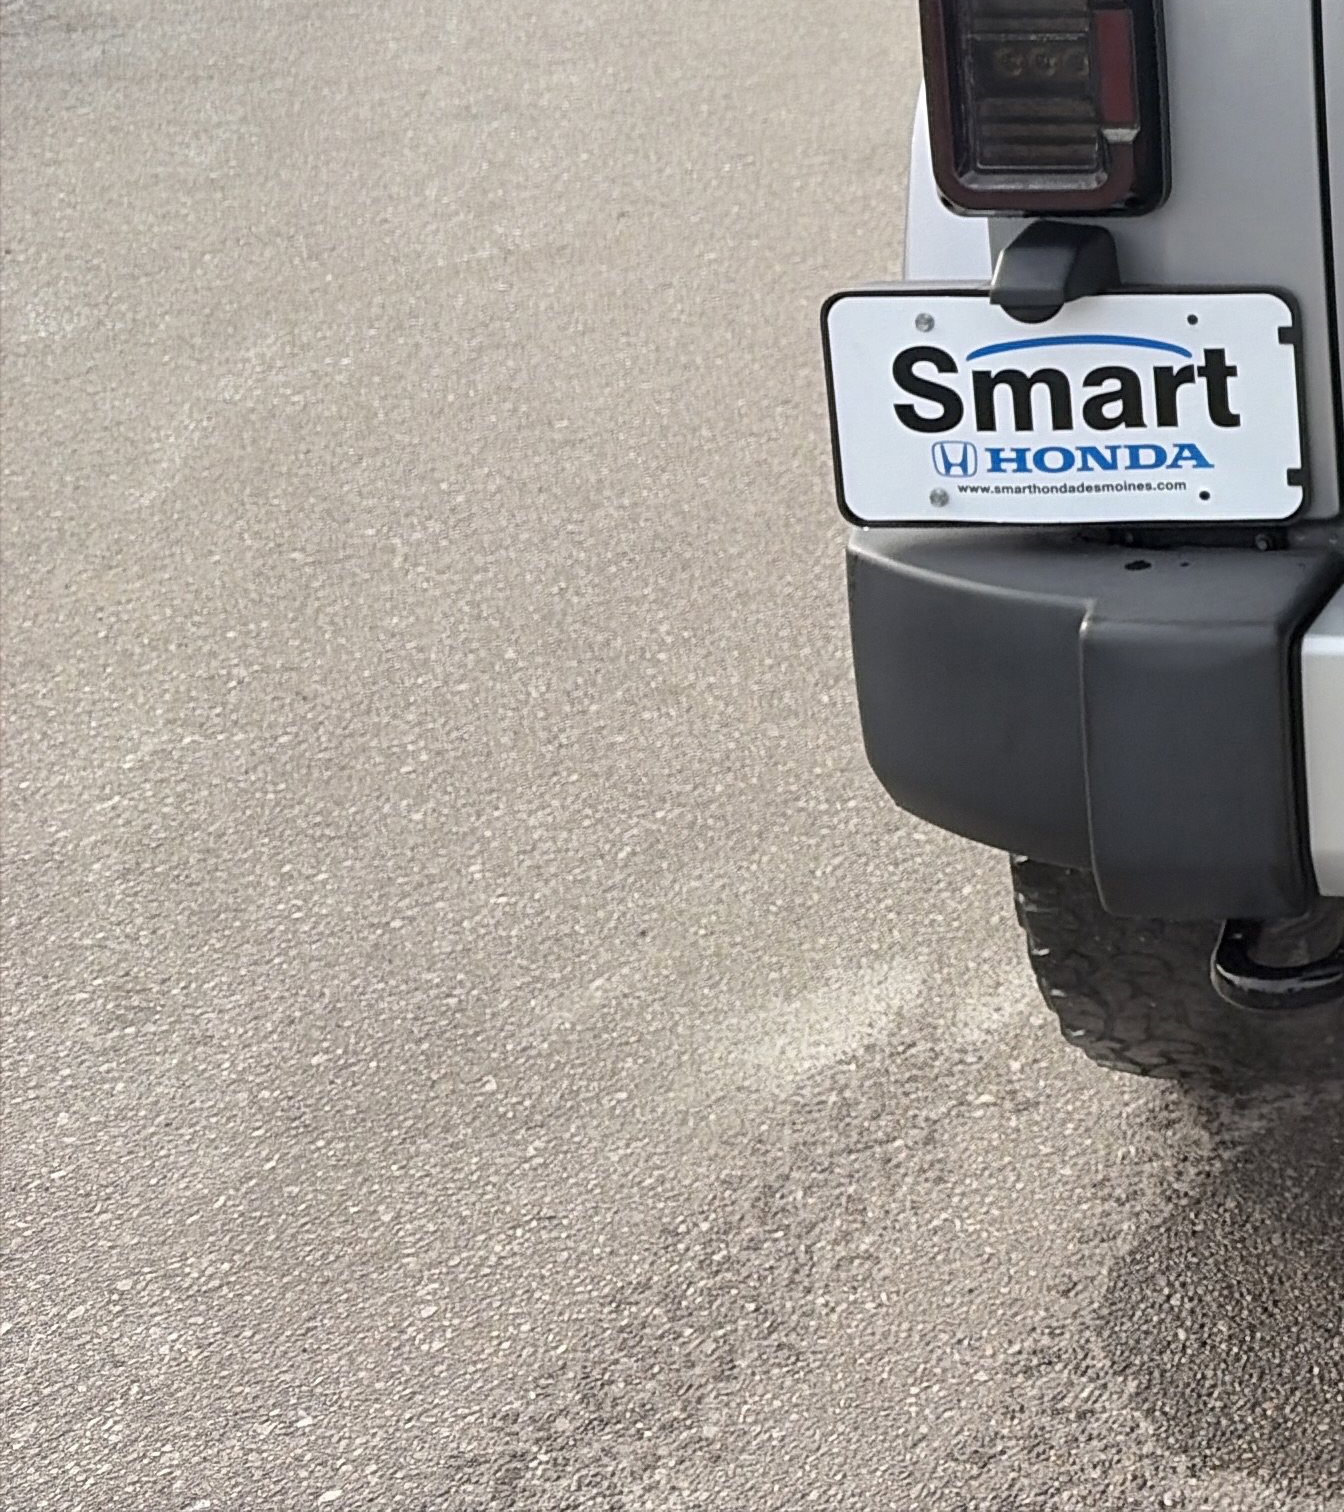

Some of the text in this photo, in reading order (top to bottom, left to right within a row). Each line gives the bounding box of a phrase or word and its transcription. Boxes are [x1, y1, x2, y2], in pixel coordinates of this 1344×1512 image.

[892, 345, 1242, 434] Smart
[985, 441, 1215, 475] HONDA
[957, 480, 1187, 496] www.smarthondadesmoines.com
